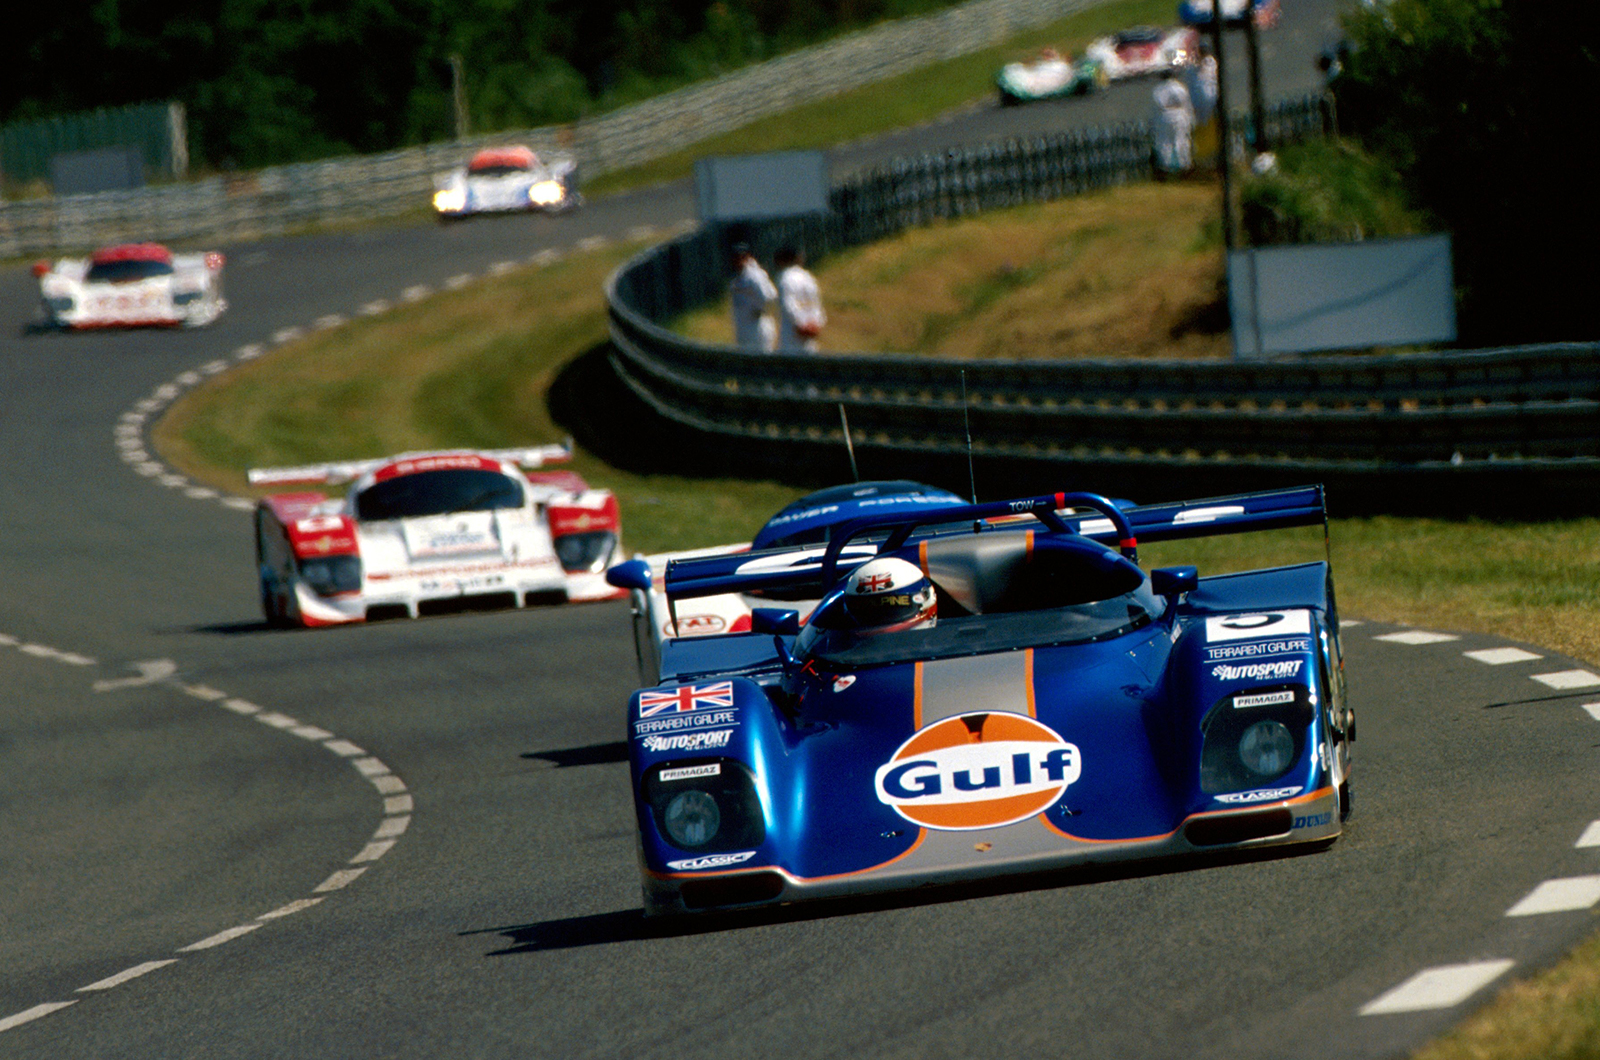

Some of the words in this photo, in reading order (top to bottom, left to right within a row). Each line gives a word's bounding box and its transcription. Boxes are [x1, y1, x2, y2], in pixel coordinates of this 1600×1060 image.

[1009, 500, 1035, 511] TOW
[1208, 643, 1268, 659] TERRARENT
[1267, 640, 1310, 653] GRUPPE
[1219, 660, 1304, 681] AUTOSPORT
[1237, 694, 1291, 706] PRIMAGAZ
[635, 717, 694, 734] TERRARENT
[693, 712, 735, 726] GRUPPE
[650, 729, 734, 752] AUTOSPORT
[662, 766, 717, 779] PRIMAGAZ
[883, 749, 1073, 800] Gulf
[1228, 788, 1292, 802] CLASSIC
[680, 854, 744, 868] CLASSIC
